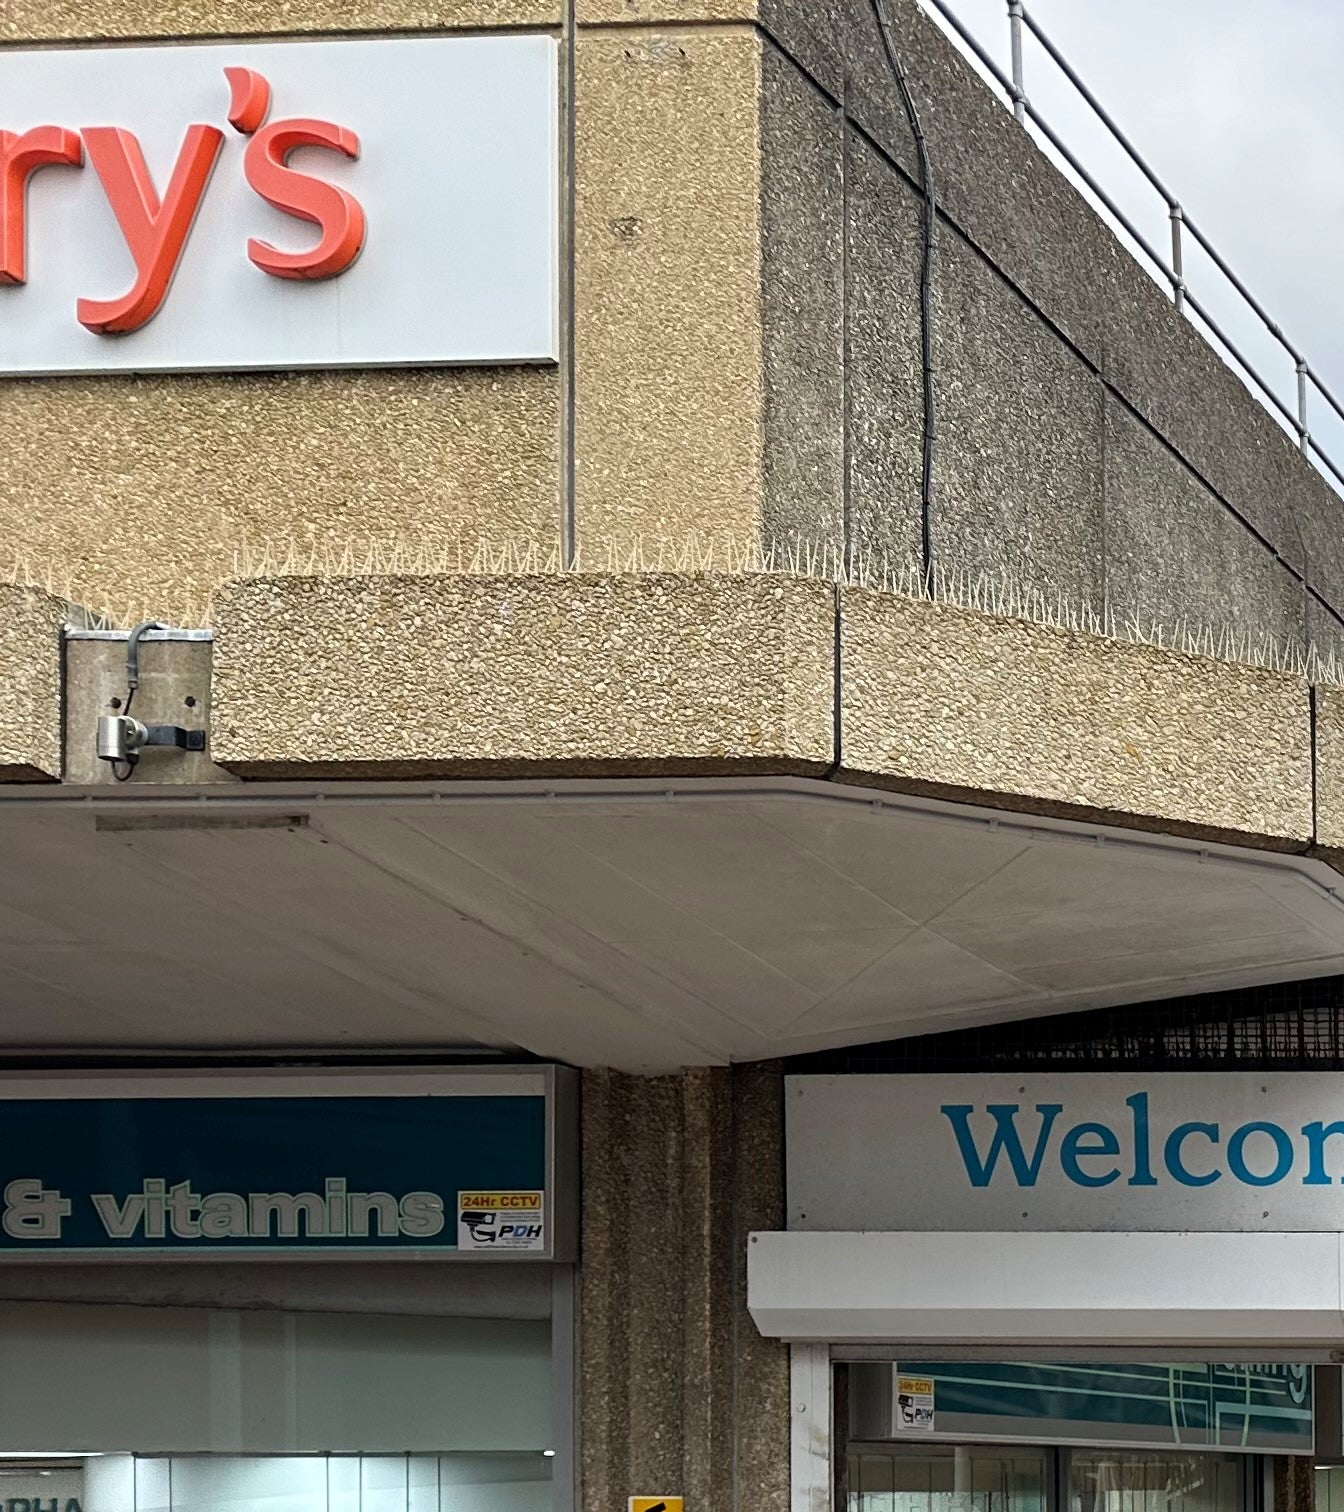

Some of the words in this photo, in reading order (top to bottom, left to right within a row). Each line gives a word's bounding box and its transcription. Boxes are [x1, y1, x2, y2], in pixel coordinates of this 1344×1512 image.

[2, 1178, 71, 1239] &
[91, 1177, 446, 1239] vitamins
[463, 1196, 497, 1207] 24Hr
[500, 1195, 538, 1207] CCTV
[498, 1224, 542, 1238] PDH
